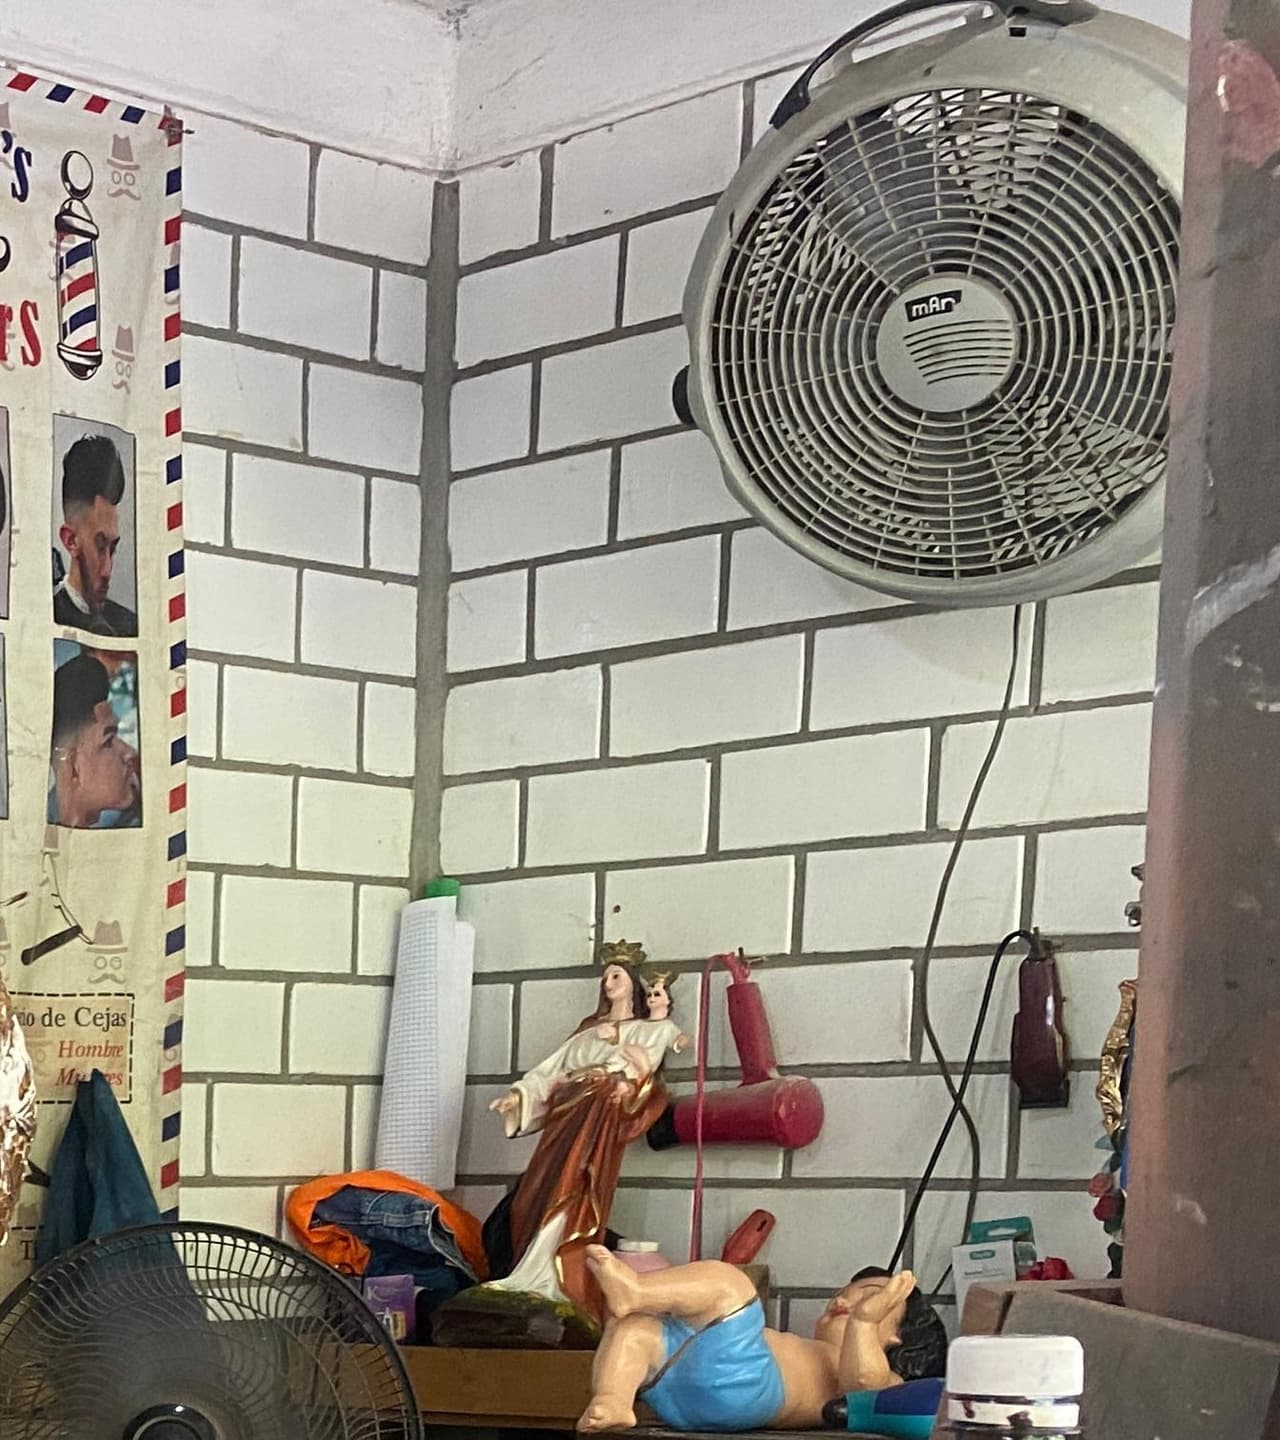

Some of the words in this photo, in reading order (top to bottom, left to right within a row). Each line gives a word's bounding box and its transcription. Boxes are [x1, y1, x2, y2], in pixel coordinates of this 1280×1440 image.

[41, 1007, 67, 1028] de
[74, 1006, 127, 1032] Cejas
[57, 1040, 125, 1058] Hombre
